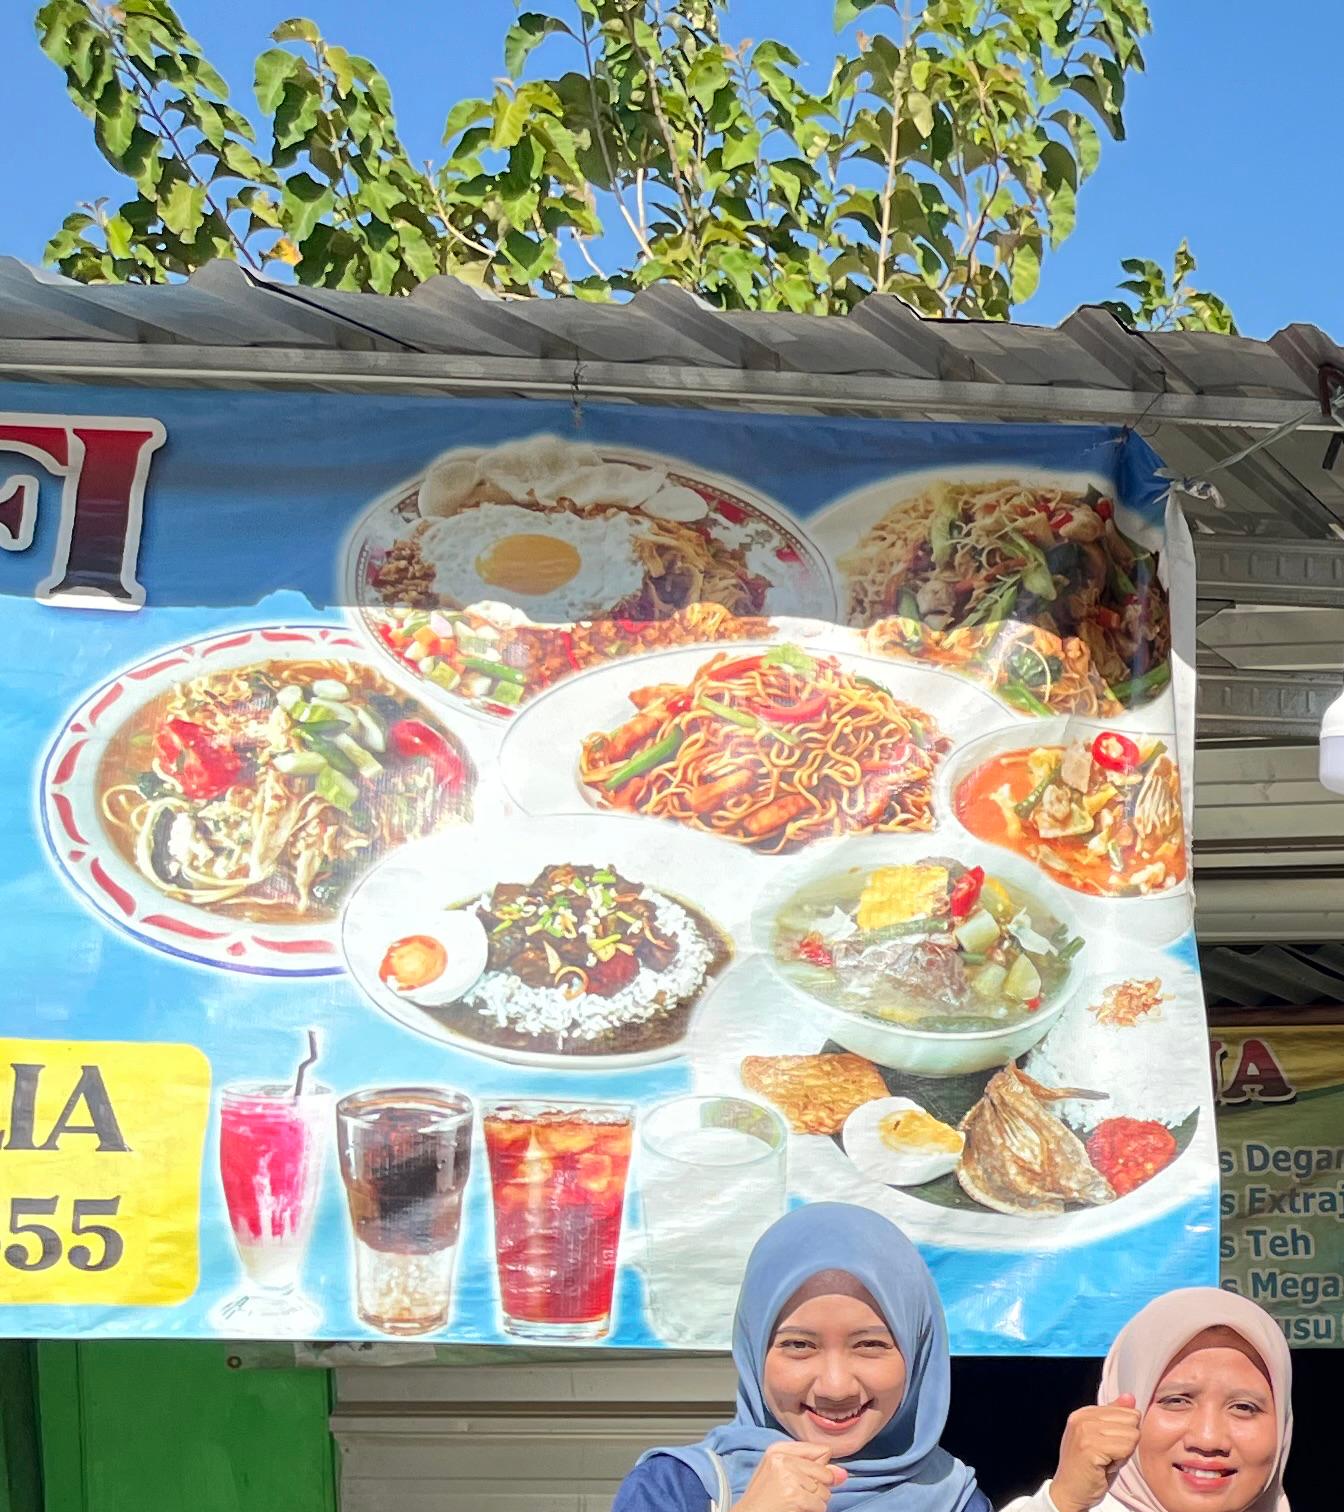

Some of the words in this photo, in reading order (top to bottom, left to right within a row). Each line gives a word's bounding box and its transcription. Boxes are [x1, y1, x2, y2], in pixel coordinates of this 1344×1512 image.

[0, 1063, 133, 1152] IA
[1246, 1228, 1311, 1256] Teh
[1251, 1271, 1340, 1306] Mega
[1277, 1317, 1332, 1340] usu
